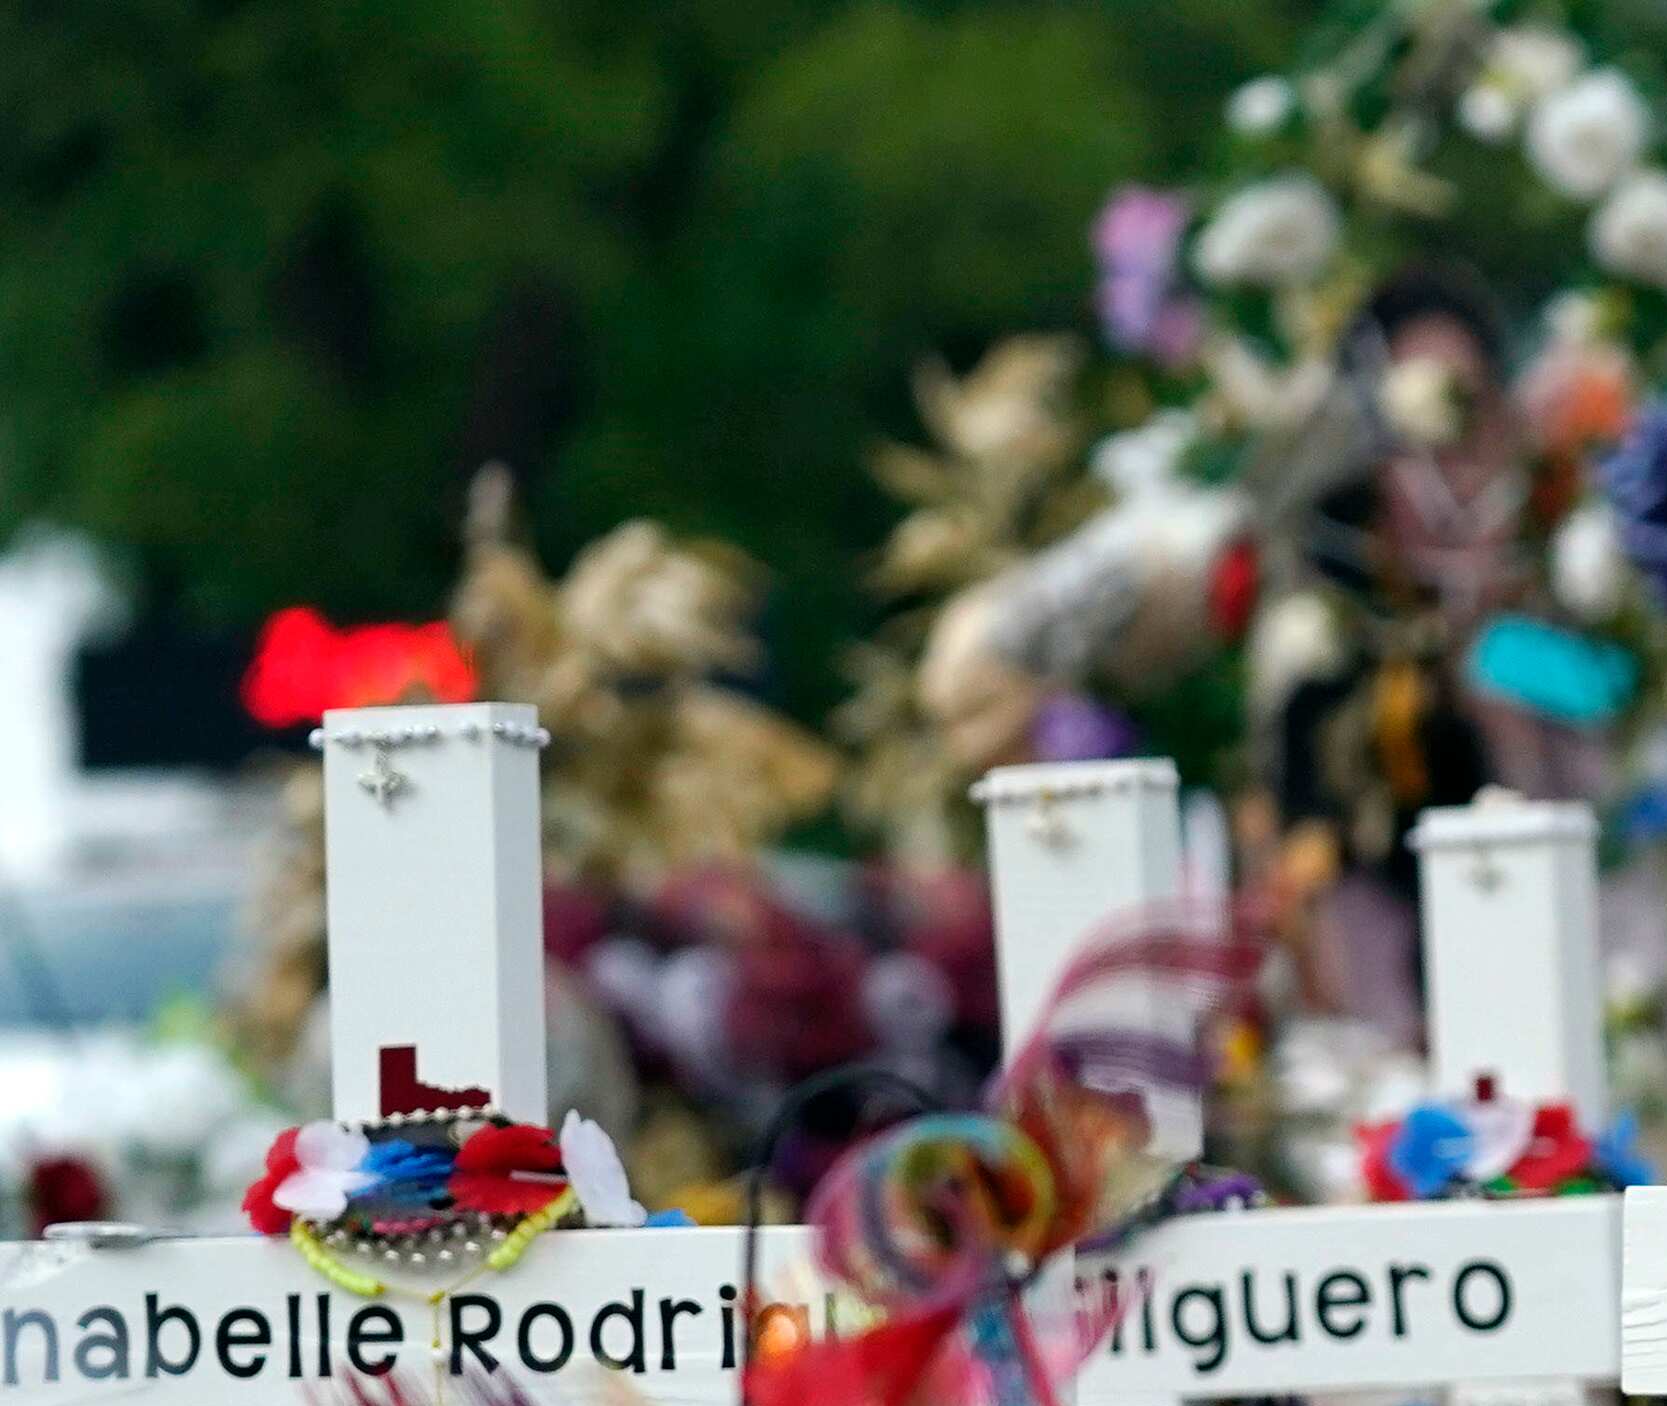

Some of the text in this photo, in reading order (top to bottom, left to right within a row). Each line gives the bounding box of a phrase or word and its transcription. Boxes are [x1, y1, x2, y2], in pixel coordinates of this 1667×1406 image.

[2, 1284, 842, 1387] nabelle Rodri
[1074, 1258, 1515, 1374] ilguero
